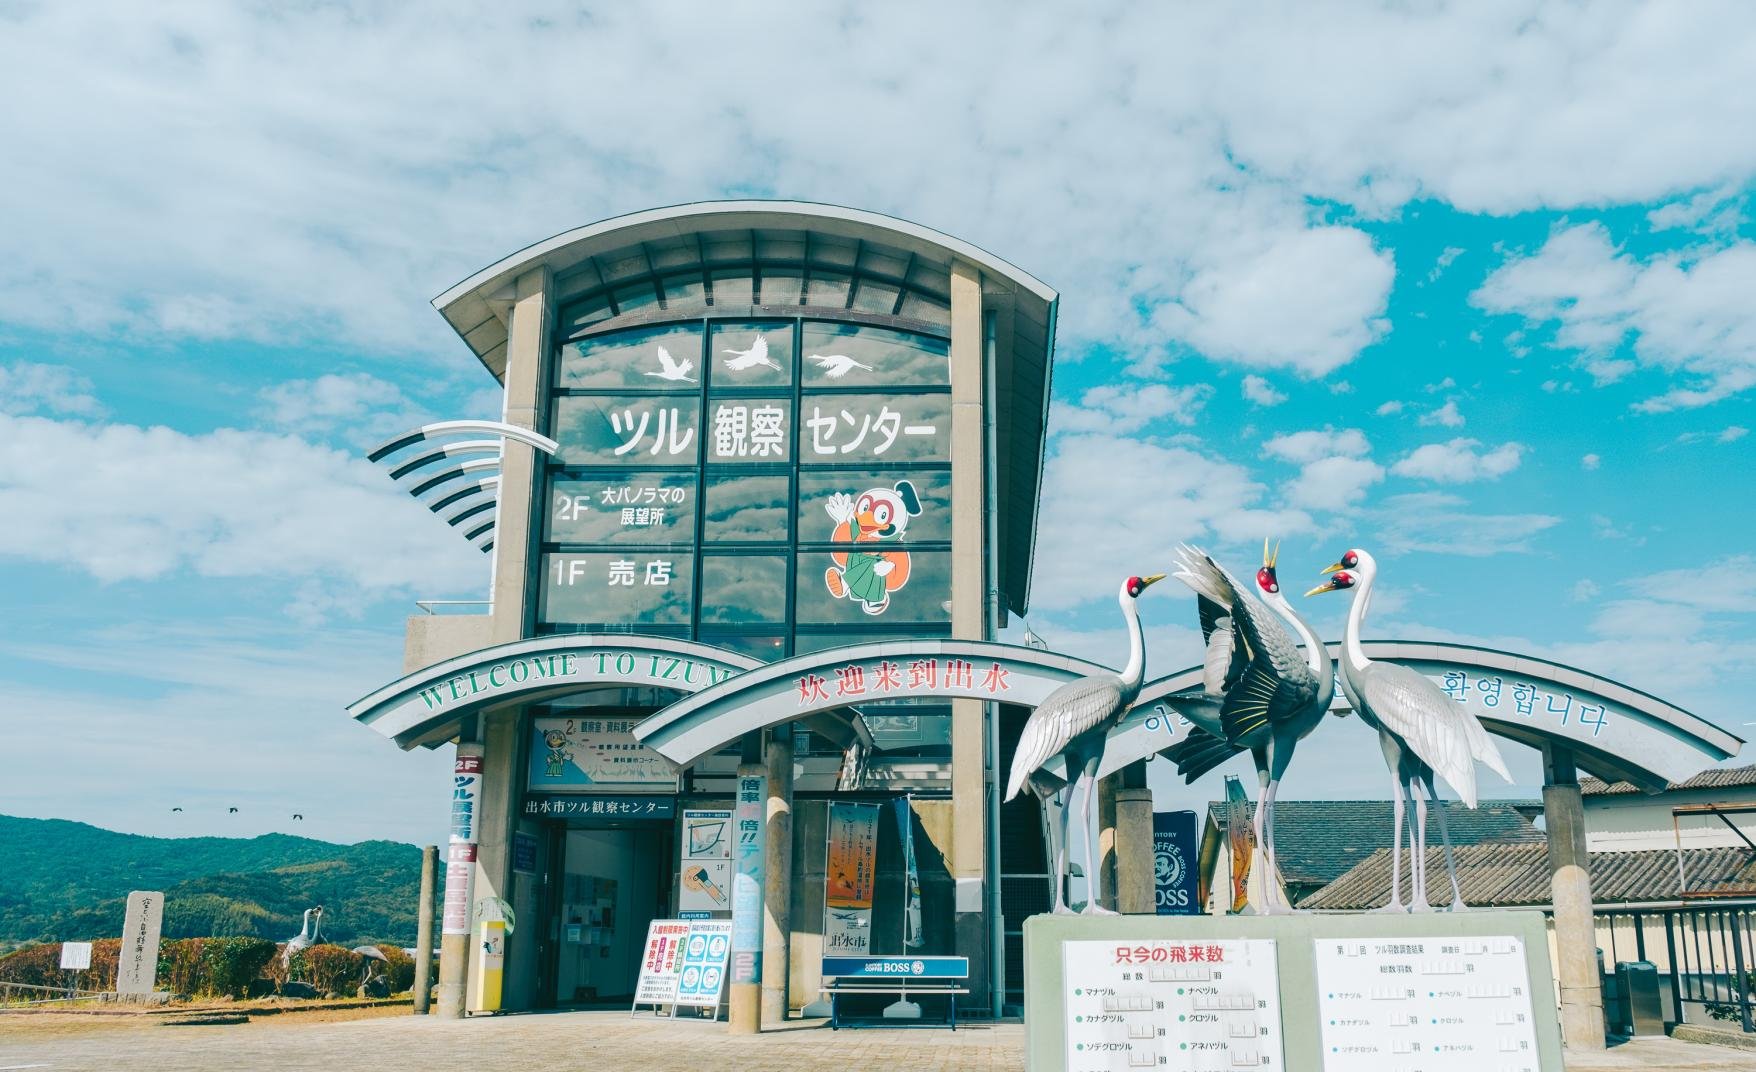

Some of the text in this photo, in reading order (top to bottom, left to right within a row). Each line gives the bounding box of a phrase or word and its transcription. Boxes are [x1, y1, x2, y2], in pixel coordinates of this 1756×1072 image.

[611, 405, 936, 457] ツル観察センター
[602, 486, 685, 505] 大パノラマの
[555, 496, 591, 522] 2F
[620, 508, 665, 526] 展望所
[554, 560, 587, 587] 1F
[608, 560, 672, 586] 売店
[417, 653, 578, 712] WELCOME
[592, 652, 636, 676] TO
[793, 658, 1011, 706] 欢迎来到出水
[1441, 672, 1609, 738] 환영합니다
[455, 760, 479, 771] 2F
[525, 800, 669, 814] 出水市ツル観察センター
[884, 963, 910, 973] BOSS
[1116, 946, 1225, 964] 只今の飛来数
